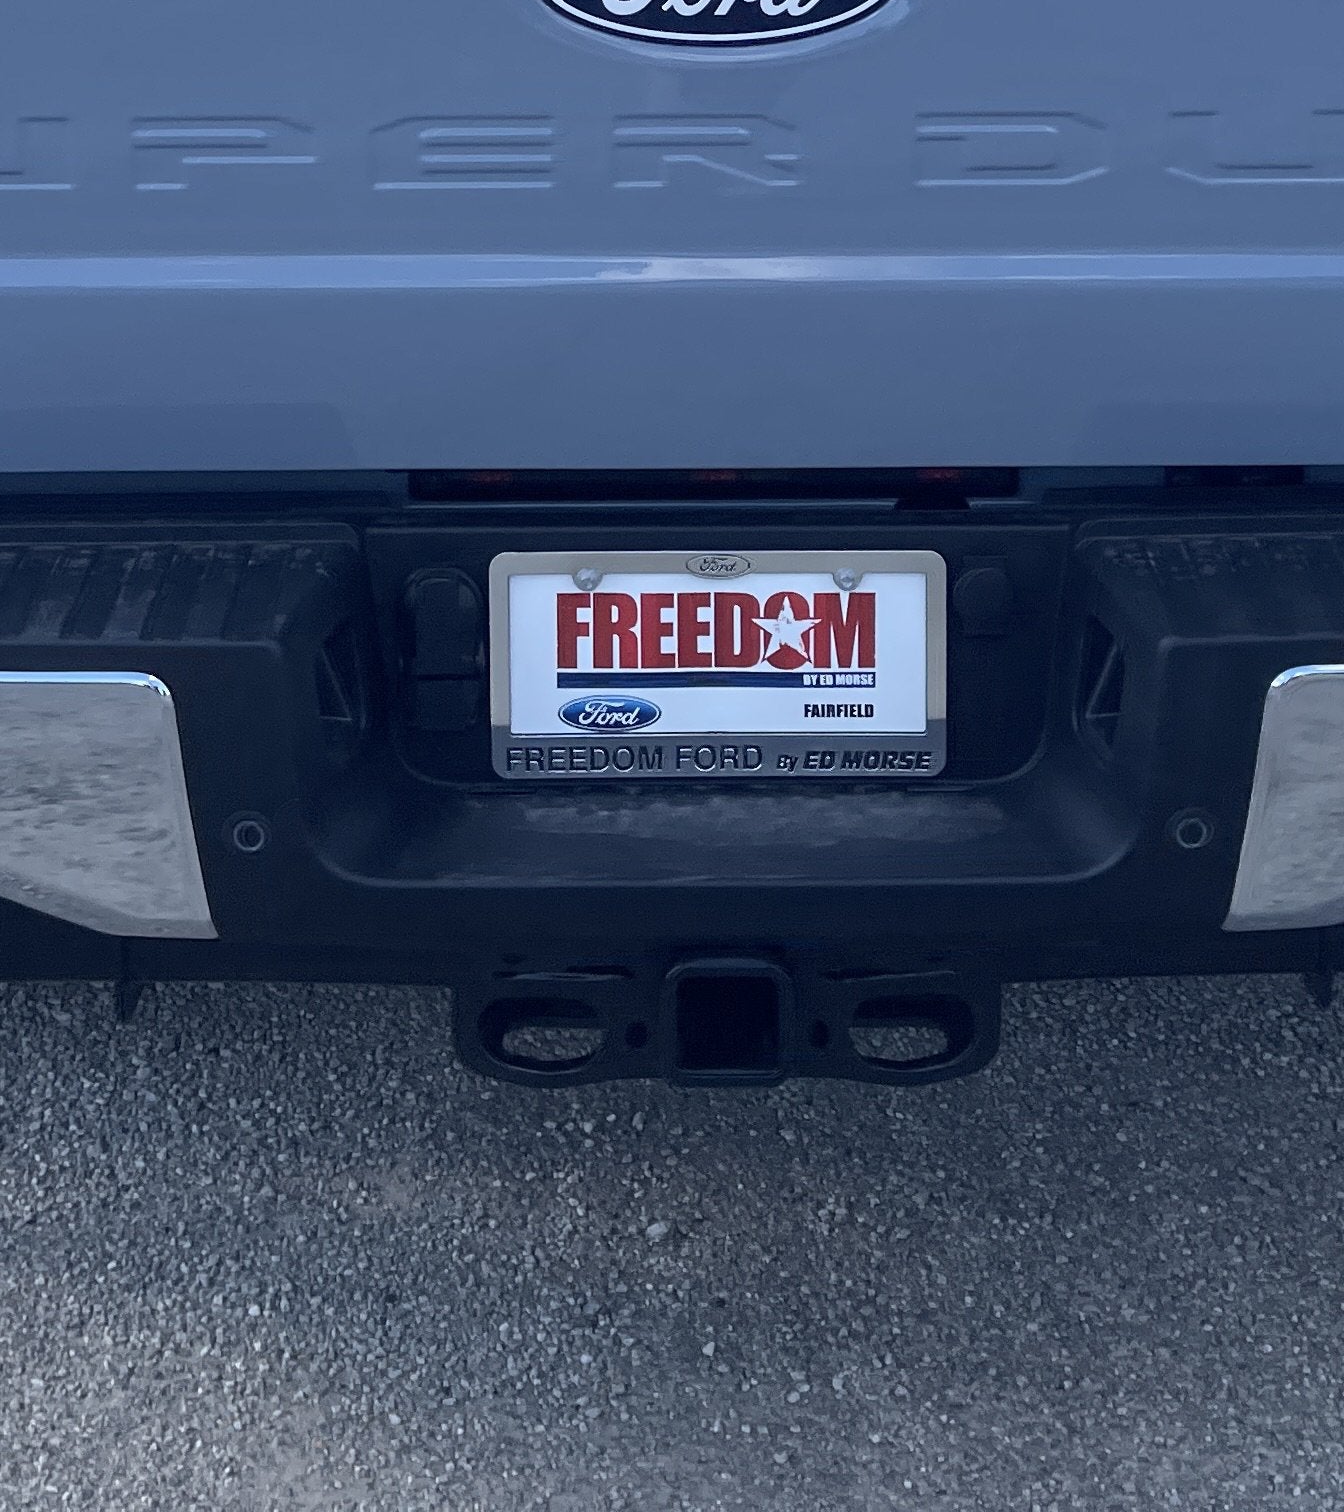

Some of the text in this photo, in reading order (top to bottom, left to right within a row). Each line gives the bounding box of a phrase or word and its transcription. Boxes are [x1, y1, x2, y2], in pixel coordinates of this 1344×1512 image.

[700, 557, 737, 572] Ford
[557, 591, 875, 670] FREEDOM
[803, 674, 874, 686] BY ED MORSE
[578, 700, 641, 727] Ford
[803, 703, 874, 718] FAIRFIELD
[506, 744, 932, 774] FREEDOM FORD By ED MORSE
